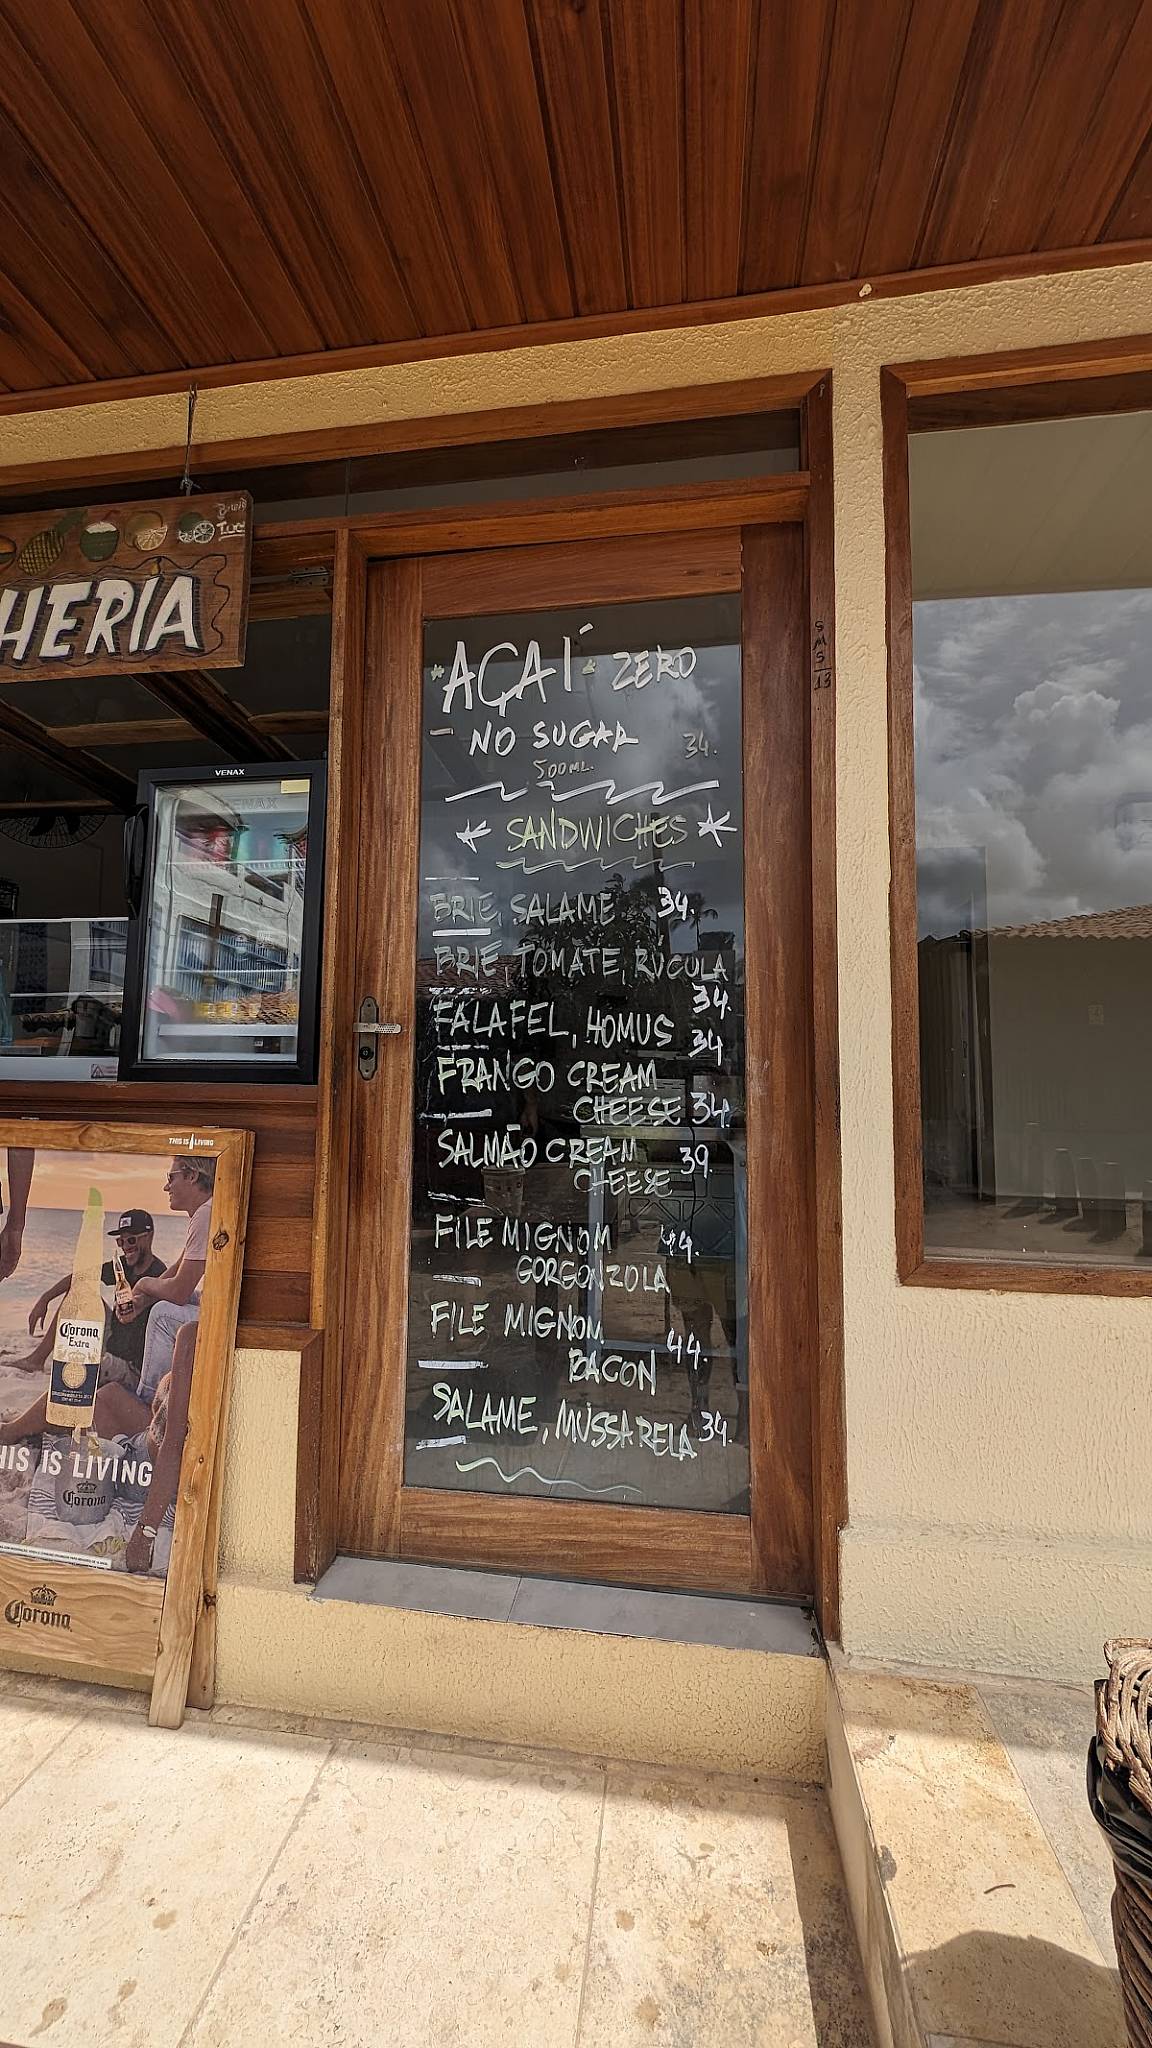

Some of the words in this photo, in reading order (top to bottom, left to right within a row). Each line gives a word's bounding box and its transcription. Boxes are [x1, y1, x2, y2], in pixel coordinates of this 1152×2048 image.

[611, 645, 697, 691] ZERO
[468, 720, 517, 756] NO
[532, 719, 640, 753] SUGAR
[214, 768, 246, 777] VENAX
[507, 807, 689, 852] SANDWICHES
[510, 891, 616, 926] SALAME
[585, 1005, 675, 1049] HOMUS
[688, 1028, 723, 1067] 34
[436, 1049, 555, 1096] FRANGO
[567, 1059, 659, 1095] CREAM
[573, 1095, 682, 1127] CHEESE
[168, 1137, 182, 1145] THIS
[437, 1123, 538, 1169] SALMÃO
[545, 1135, 637, 1170] CREAM
[573, 1167, 673, 1198] CHEESE
[434, 1213, 494, 1250] FILE
[501, 1215, 613, 1256] MIGNOM
[516, 1254, 671, 1294] GORGONZOLA
[60, 1322, 100, 1339] Corona
[430, 1300, 490, 1341] FILE
[68, 1336, 90, 1349] Extra
[568, 1347, 657, 1397] BACON
[555, 1399, 698, 1461] MUSSARELA
[42, 1449, 63, 1475] IS
[72, 1453, 153, 1487] LIVING
[62, 1489, 106, 1508] Corona
[4, 1599, 72, 1631] Corona
